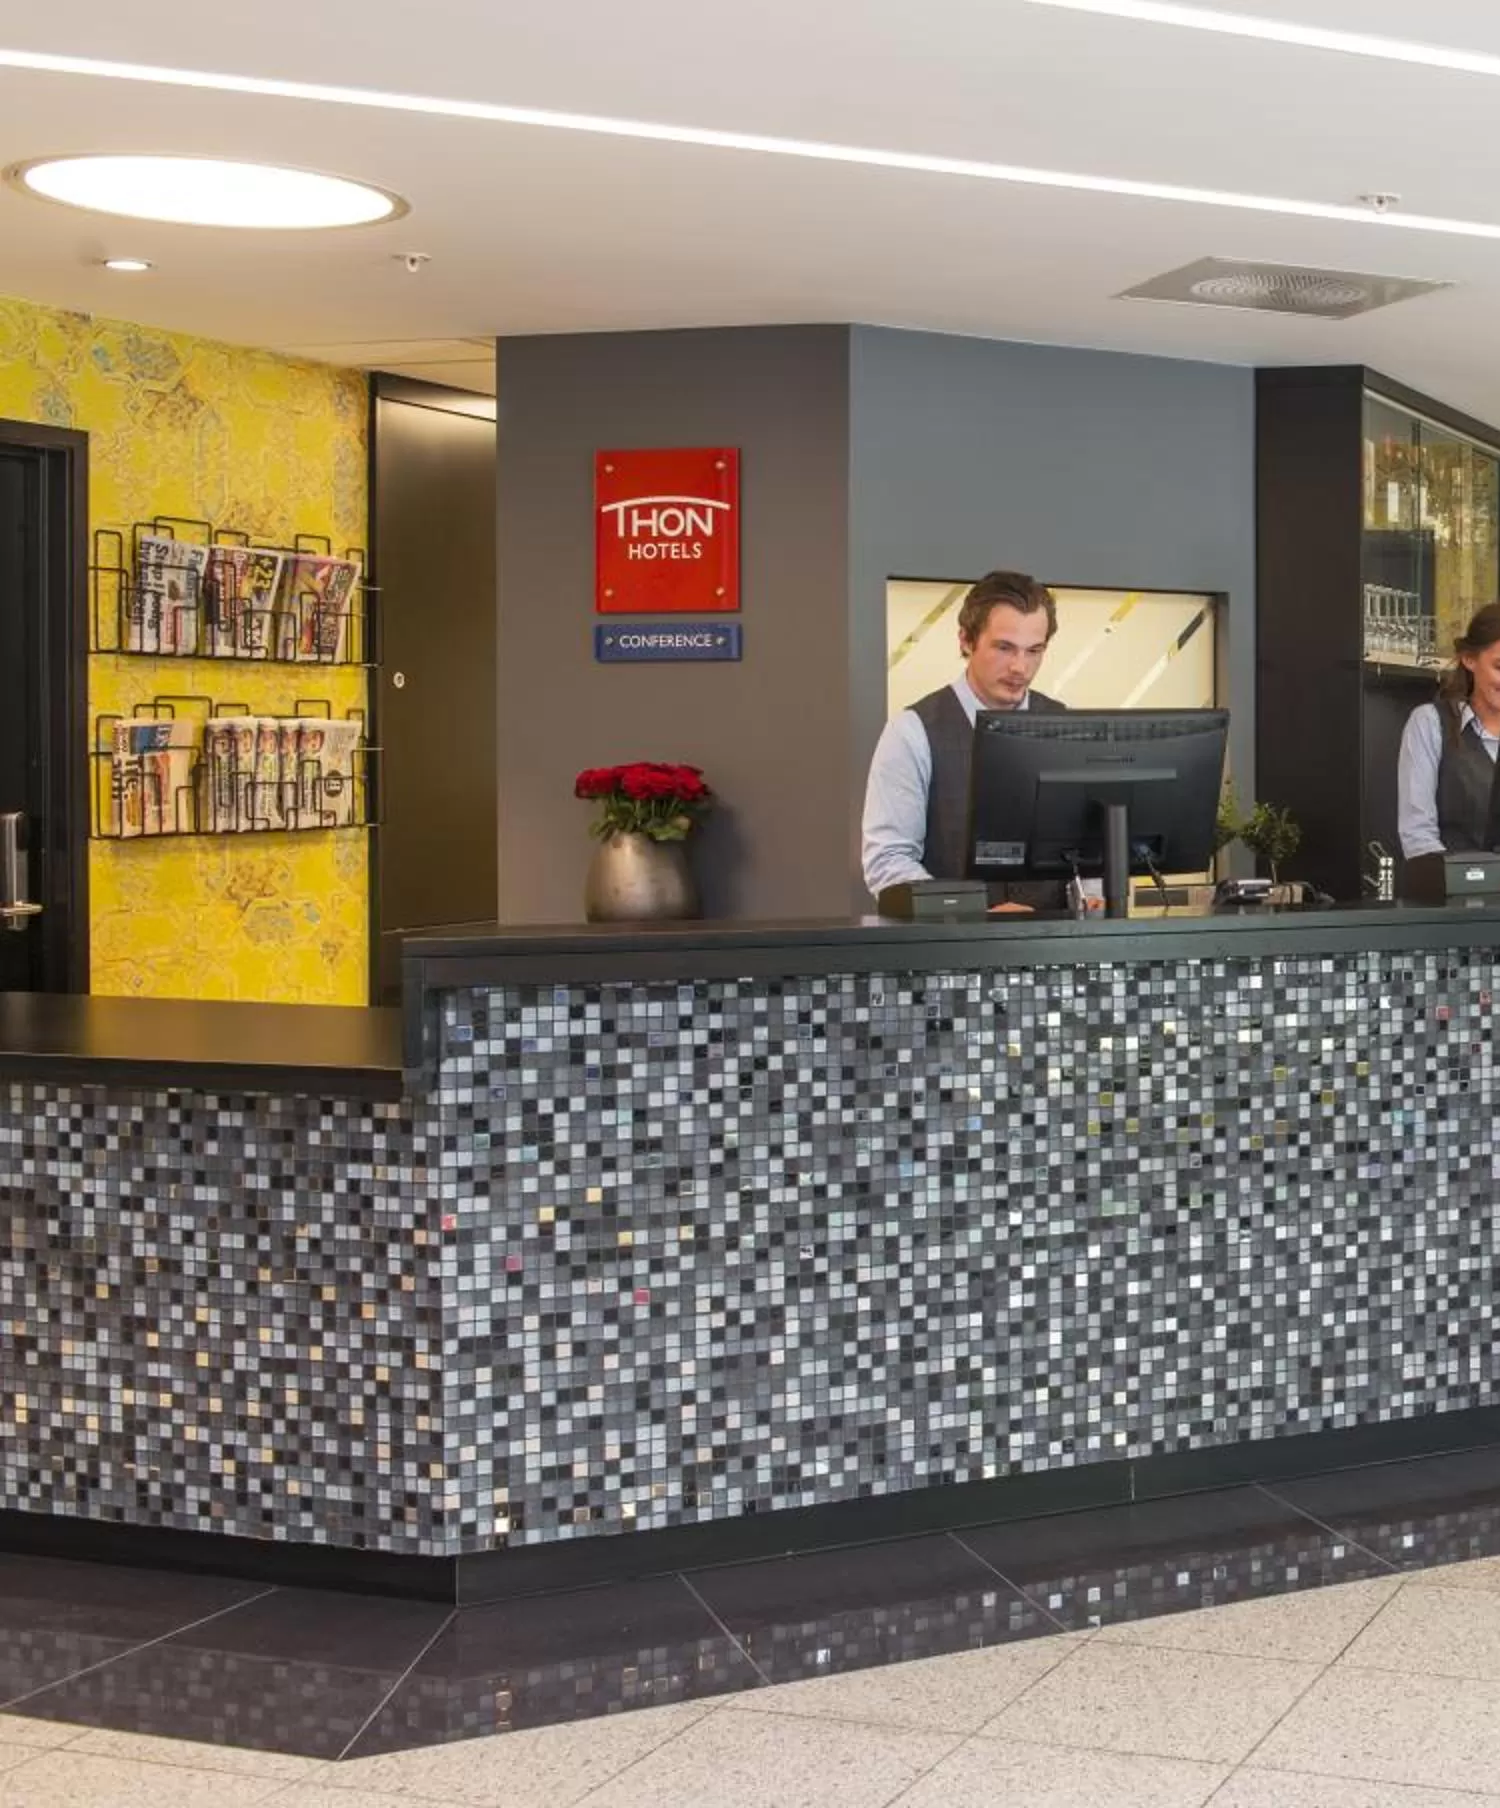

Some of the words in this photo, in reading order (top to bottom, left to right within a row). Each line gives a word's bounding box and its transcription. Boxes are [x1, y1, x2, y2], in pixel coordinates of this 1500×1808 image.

[601, 495, 731, 538] THON
[627, 542, 702, 561] HOTELS
[619, 633, 713, 649] CONFERENCE
